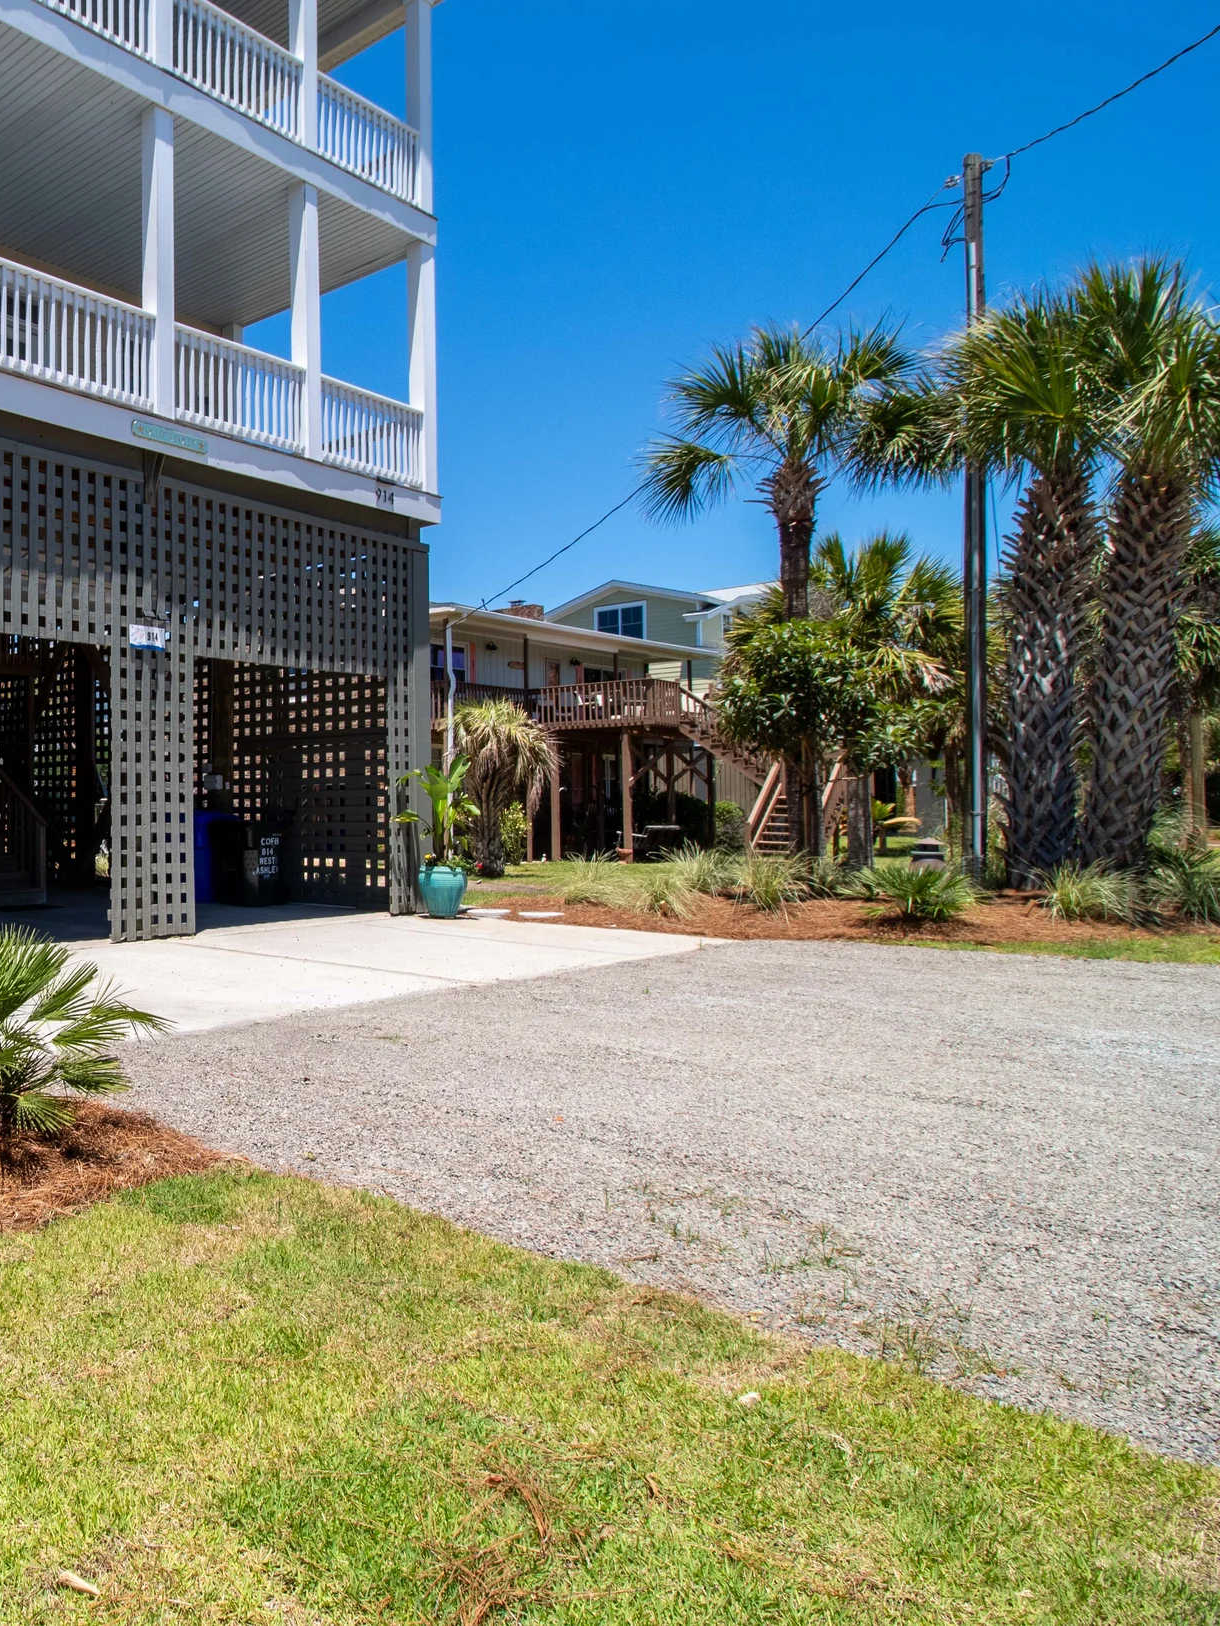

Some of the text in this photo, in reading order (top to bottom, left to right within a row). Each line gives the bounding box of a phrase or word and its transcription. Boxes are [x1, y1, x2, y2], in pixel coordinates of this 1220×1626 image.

[375, 487, 395, 506] 914
[147, 631, 158, 642] 914
[259, 856, 275, 865] WEST
